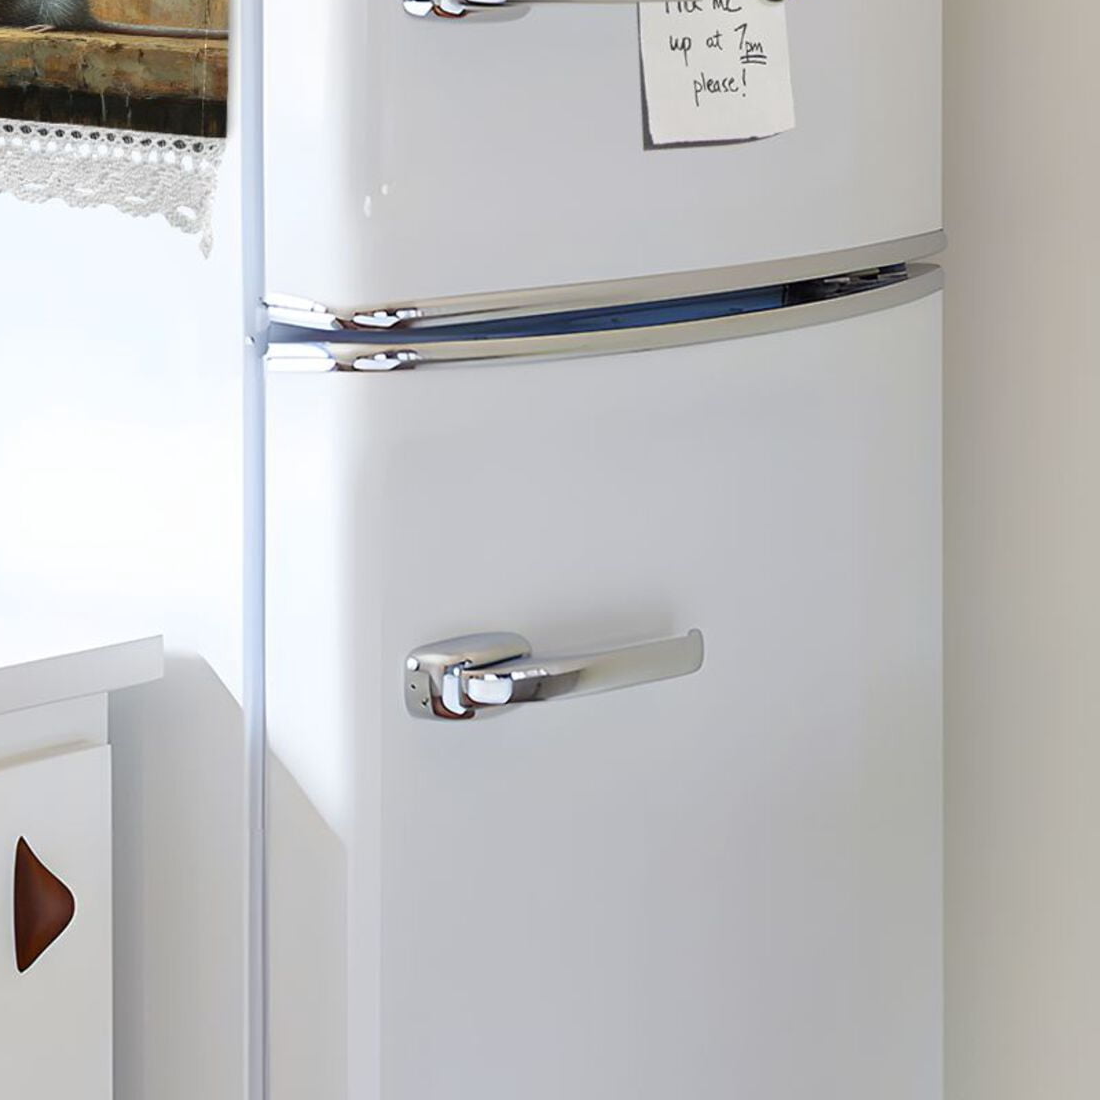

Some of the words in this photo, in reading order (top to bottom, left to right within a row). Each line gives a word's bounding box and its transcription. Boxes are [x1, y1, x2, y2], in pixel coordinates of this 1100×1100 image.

[669, 35, 692, 66] up
[706, 29, 723, 50] at
[693, 68, 747, 107] please!
